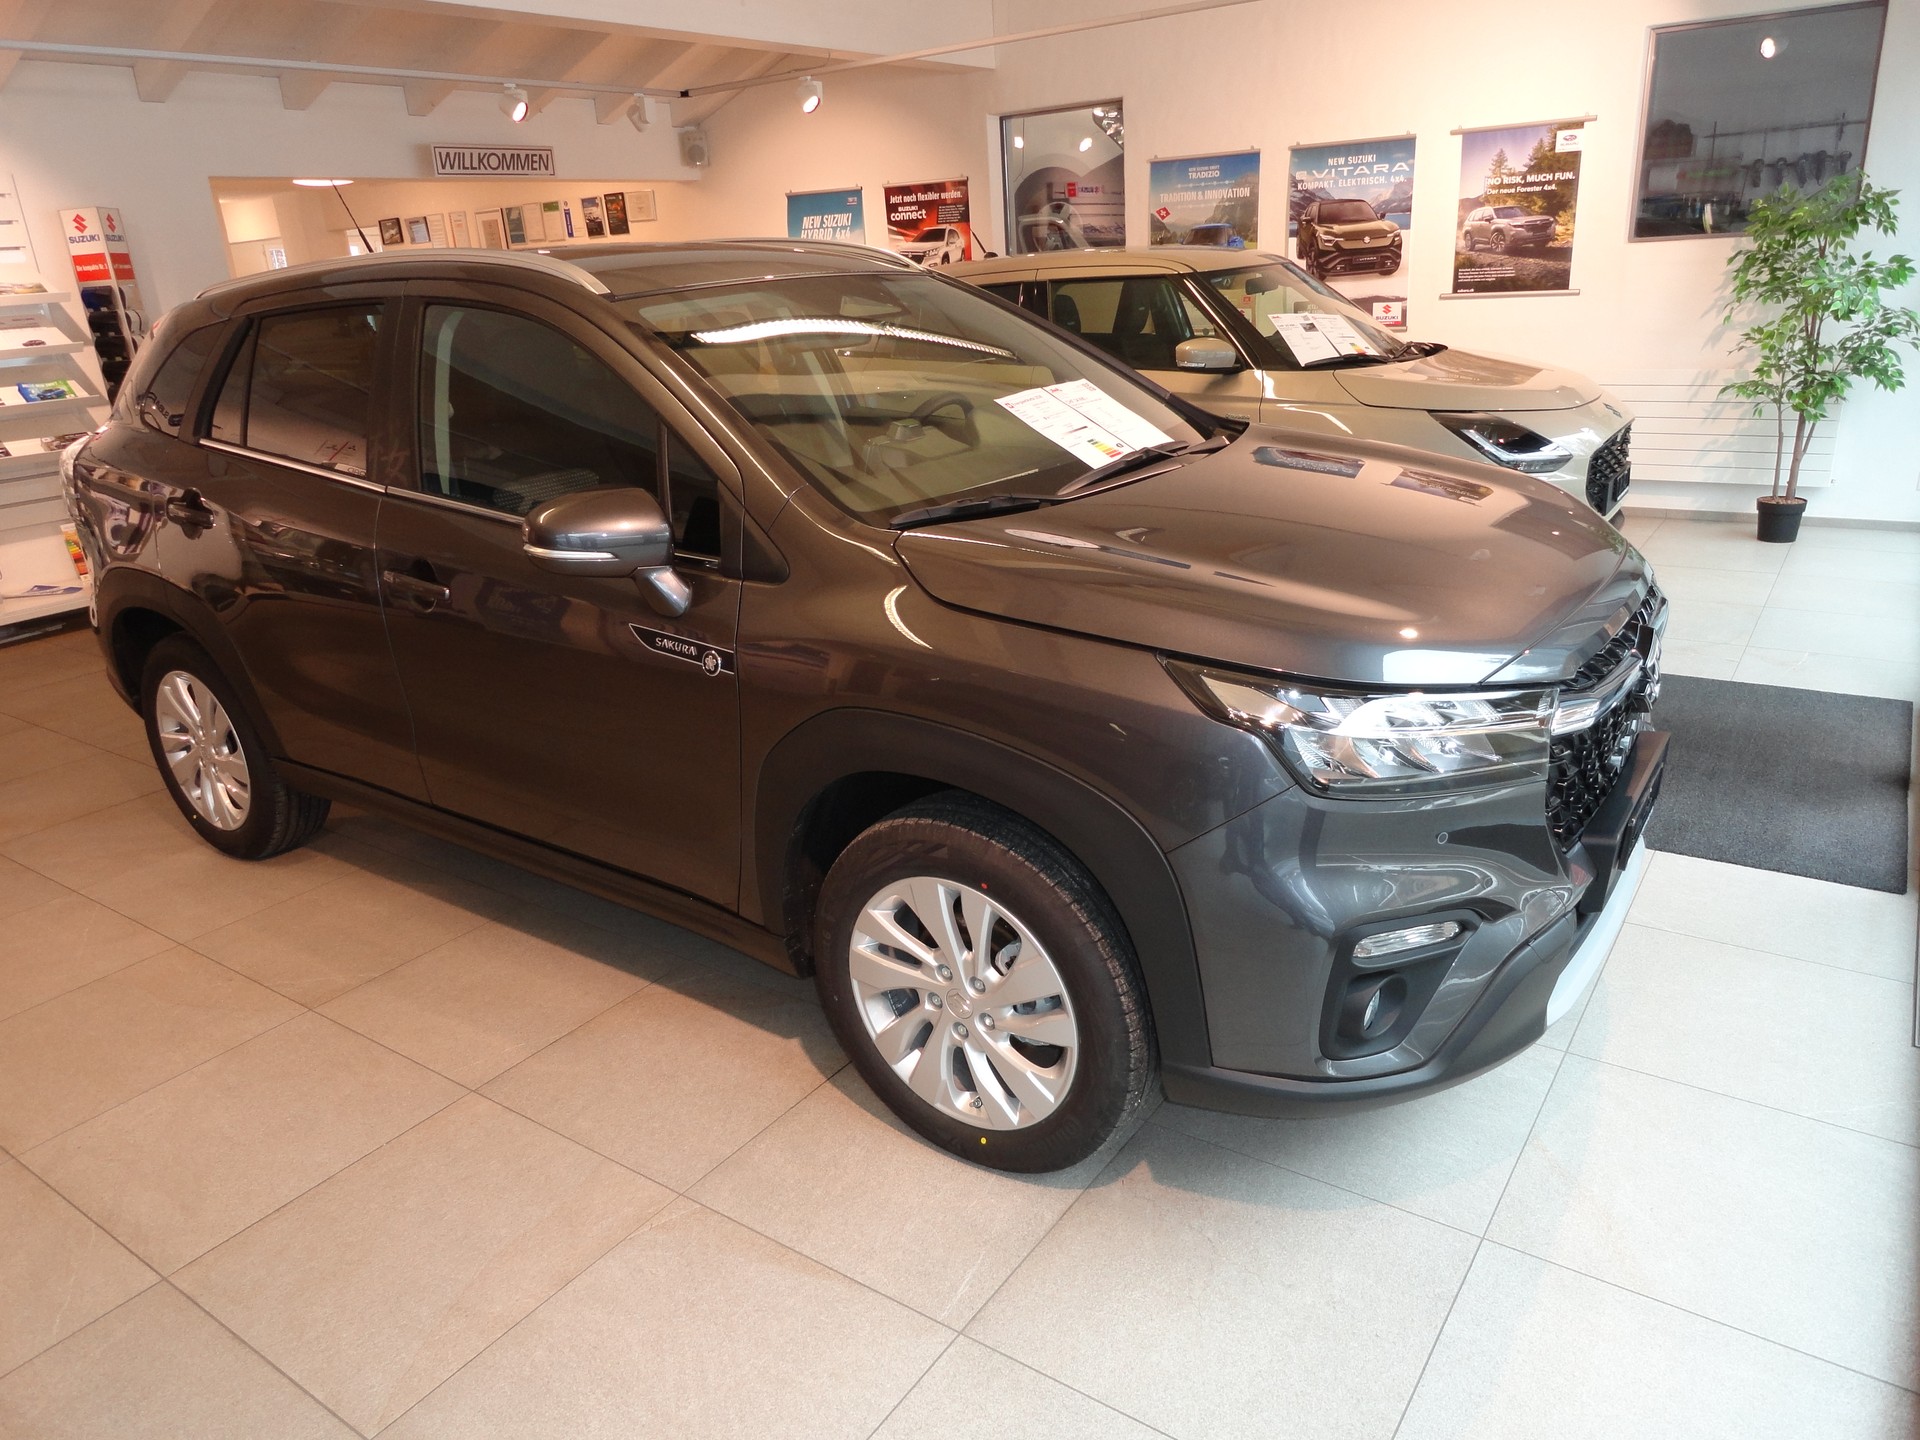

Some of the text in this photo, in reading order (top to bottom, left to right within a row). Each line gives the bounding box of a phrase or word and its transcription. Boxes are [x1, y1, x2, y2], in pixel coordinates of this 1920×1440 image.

[438, 151, 549, 171] WILLKOMMEN
[1328, 154, 1376, 166] NEW SUZUKI
[1188, 171, 1220, 180] TRADIZIO
[1312, 162, 1409, 178] VITARA
[1297, 181, 1336, 191] KOMPAKT.
[1338, 176, 1387, 187] ELEKTRISCH.
[1487, 171, 1576, 186] NO RISK, MUCH FUN.
[1160, 192, 1197, 203] TRADITION
[1204, 187, 1250, 199] INNOVATION
[1487, 187, 1499, 195] Der
[1516, 184, 1542, 193] Forester
[890, 190, 963, 204] Jetzt noch flexibler werden.
[802, 213, 852, 230] NEW SUZUKI
[890, 210, 927, 221] connect
[68, 234, 100, 244] SUZUKI
[105, 234, 125, 242] SUZUKI
[801, 228, 833, 240] HYBRID
[656, 638, 698, 656] SAKURA
